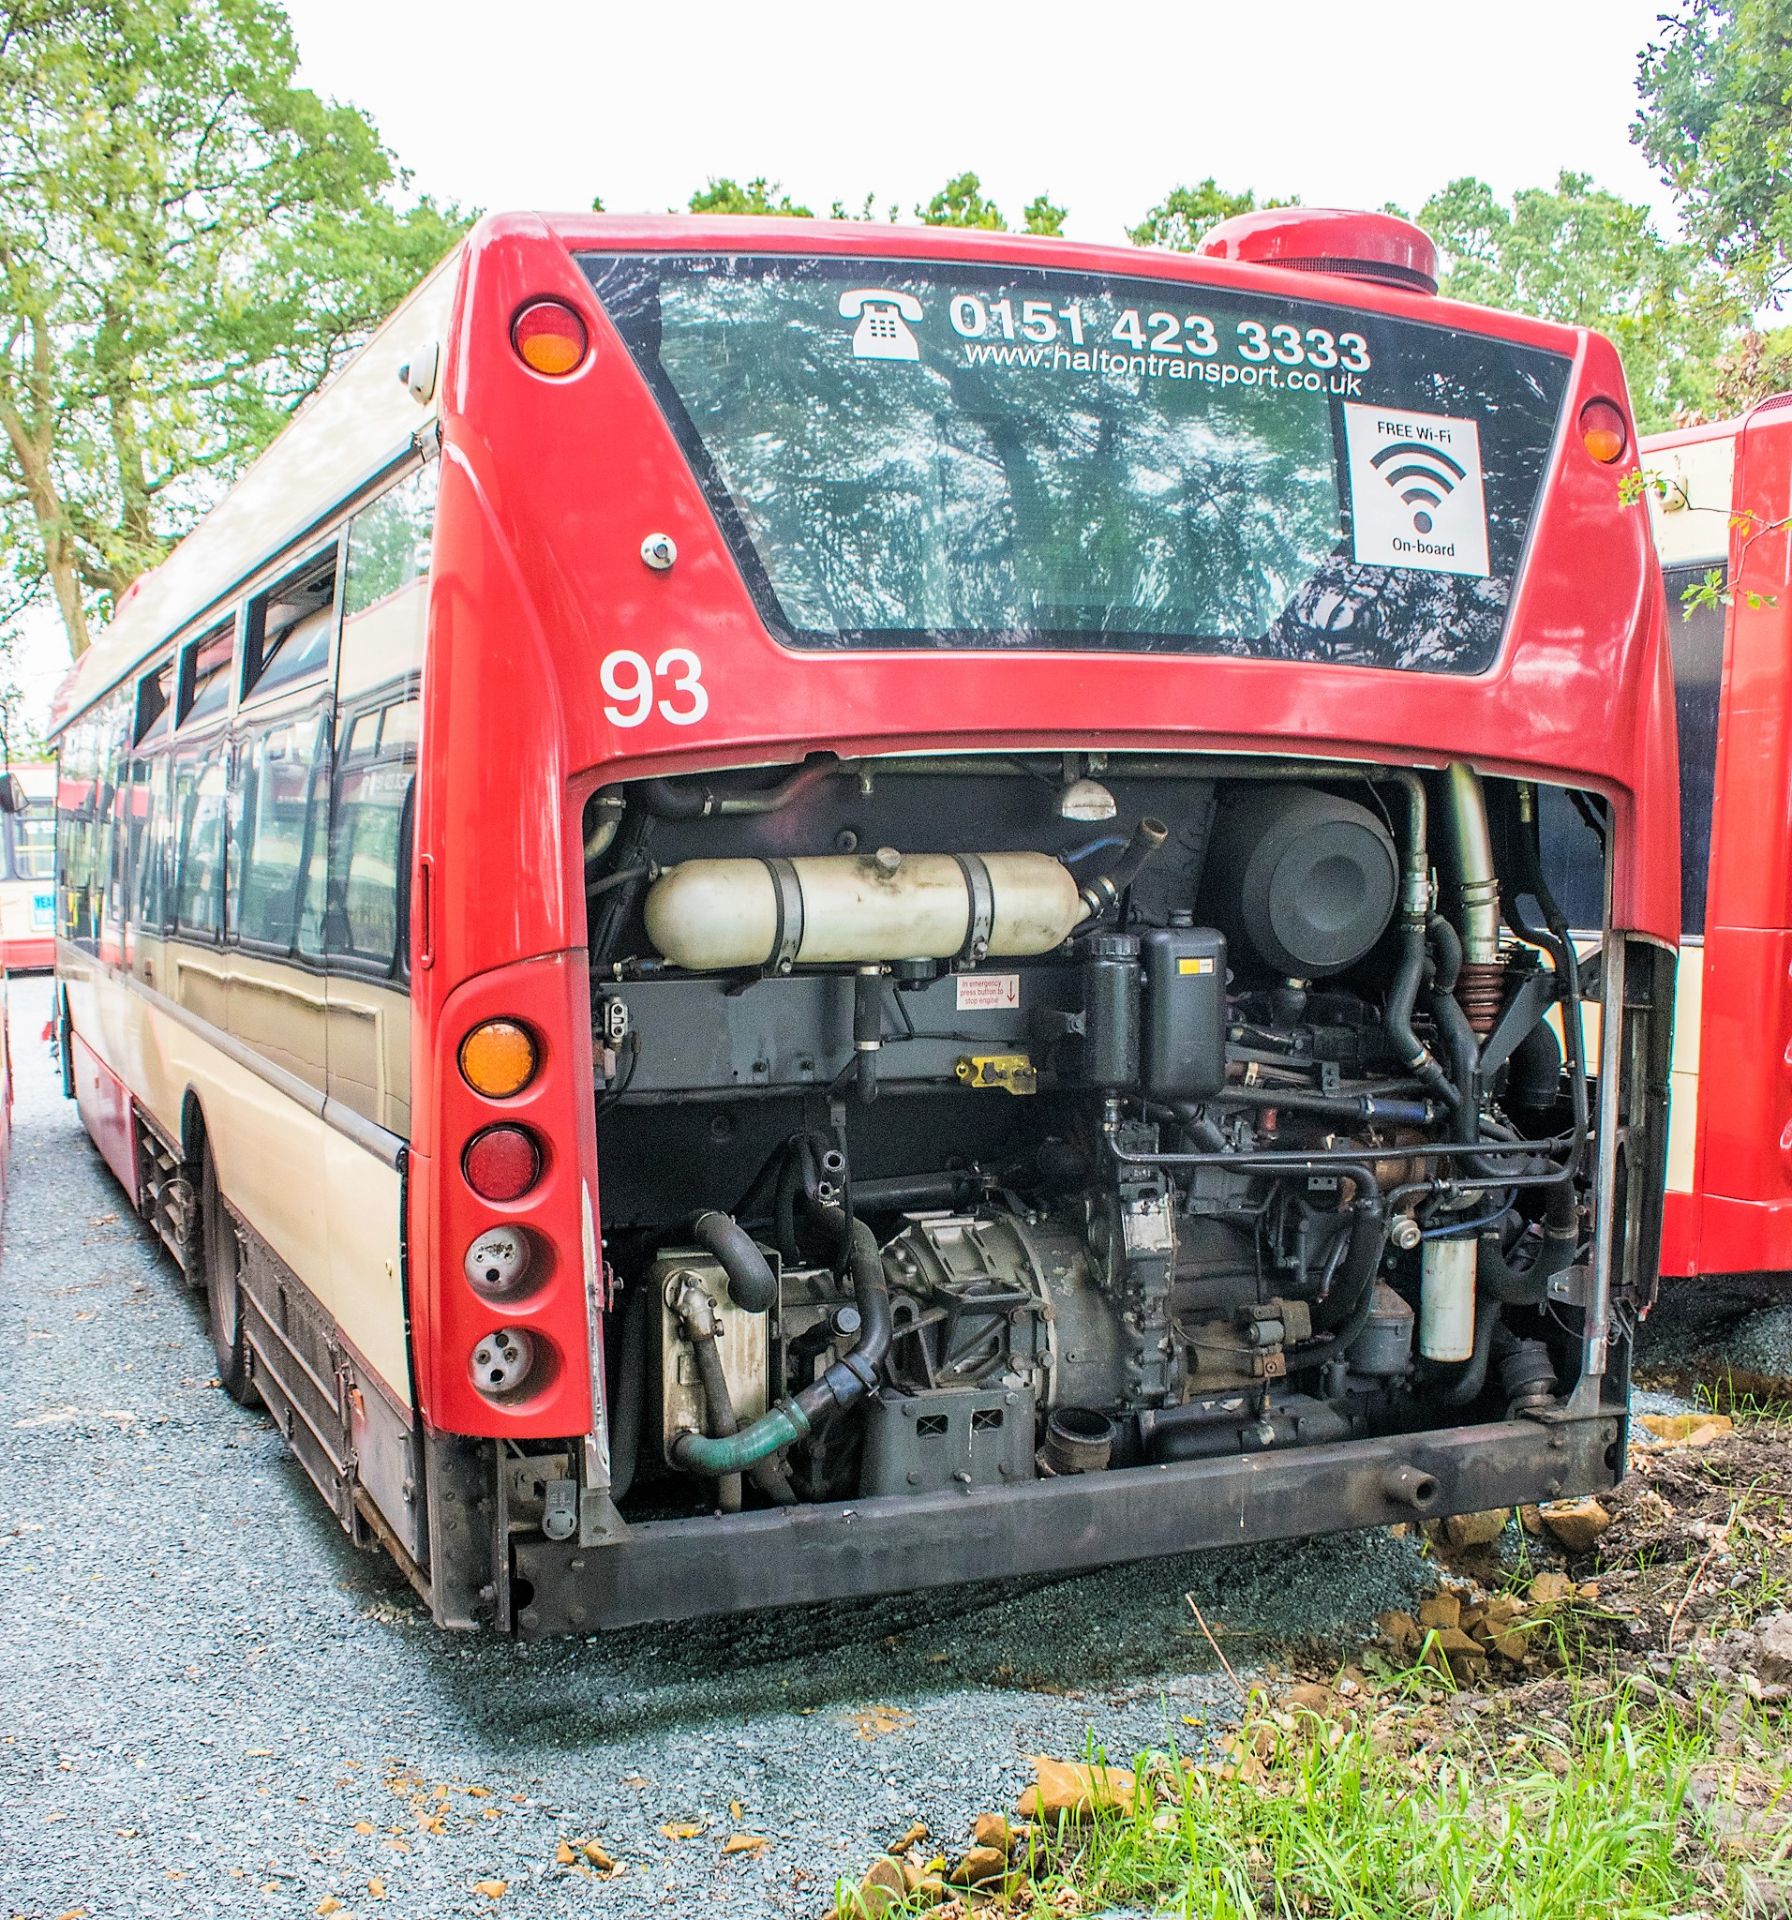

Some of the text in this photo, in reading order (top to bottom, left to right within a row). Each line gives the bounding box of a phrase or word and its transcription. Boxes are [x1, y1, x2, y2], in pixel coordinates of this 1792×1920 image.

[950, 295, 1371, 373] 0151 423 3333
[965, 343, 1362, 396] www.haltontransport.co.uk
[1377, 421, 1451, 444] FREE Wi-Fi
[1392, 537, 1455, 557] On-board
[600, 648, 709, 728] 93
[969, 980, 1001, 988] emergency
